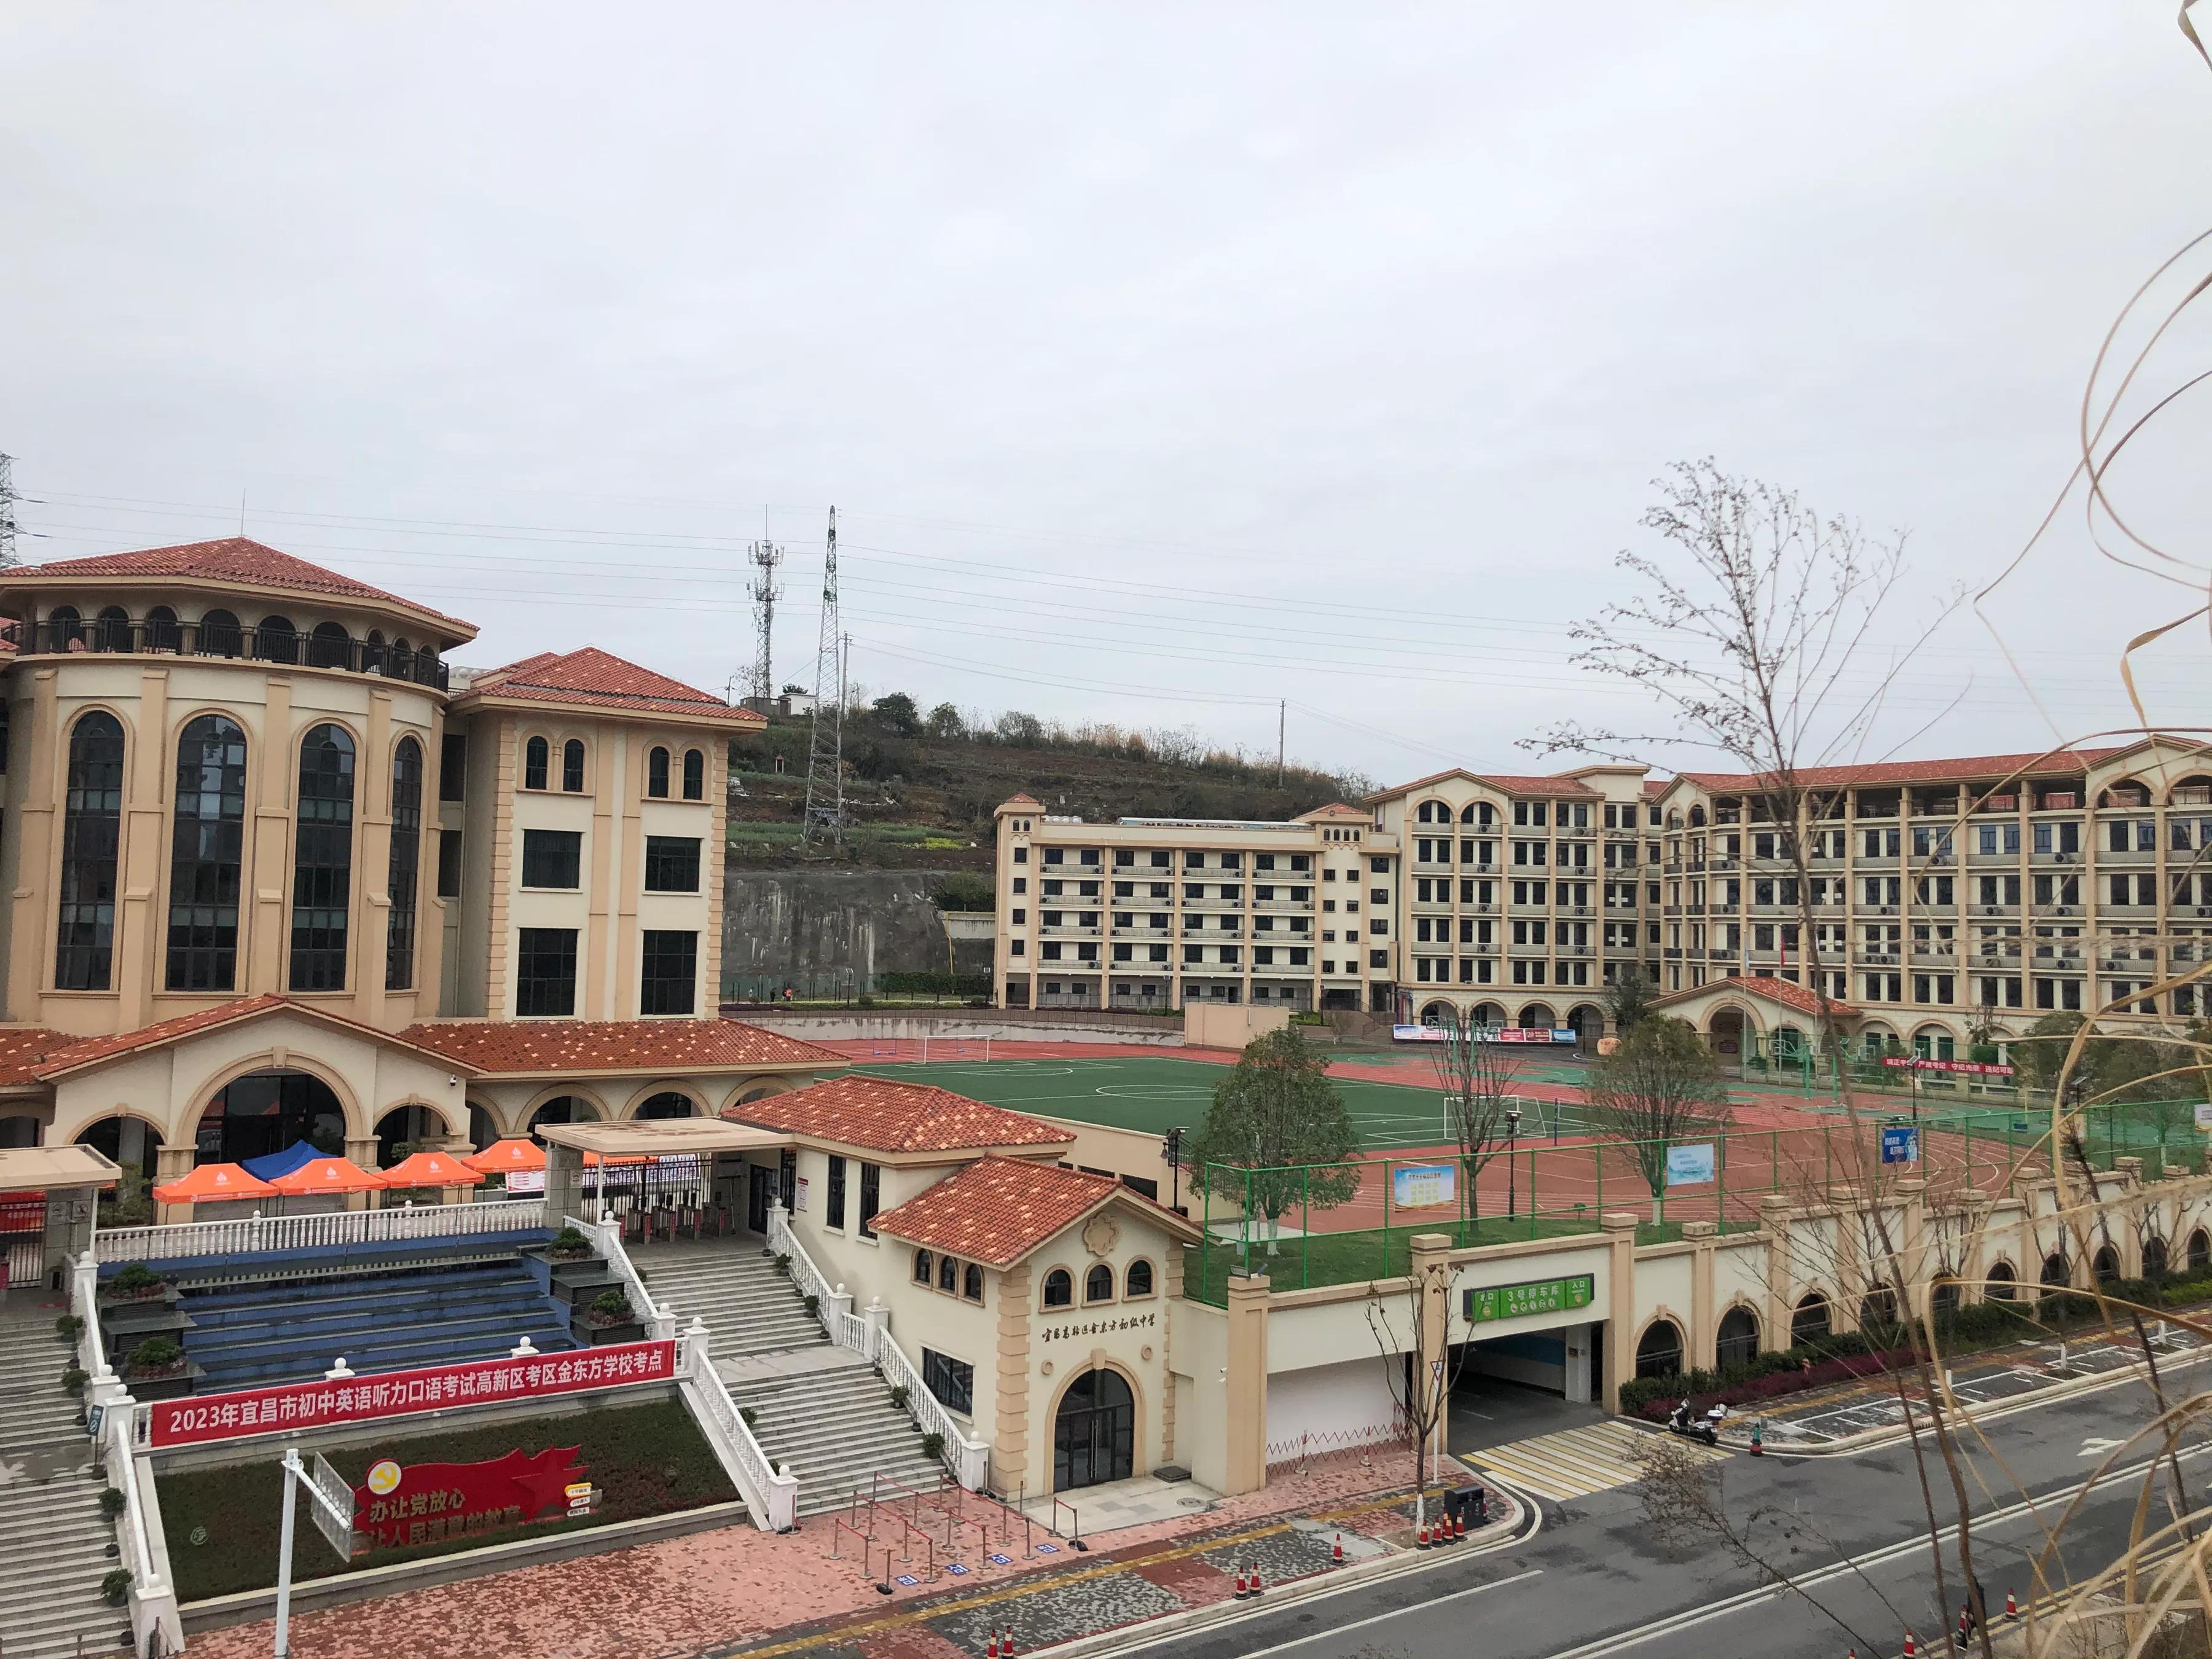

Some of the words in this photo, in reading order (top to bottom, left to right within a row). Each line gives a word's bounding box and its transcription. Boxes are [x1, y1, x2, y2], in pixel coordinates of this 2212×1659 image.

[1507, 1285, 1559, 1301] 3号停车库
[1572, 1281, 1585, 1289] 入口
[170, 1349, 663, 1433] 2023年宜昌市初中英语听力口语考试高新区考区金东方学校考点
[369, 1488, 466, 1523] 办让党放心
